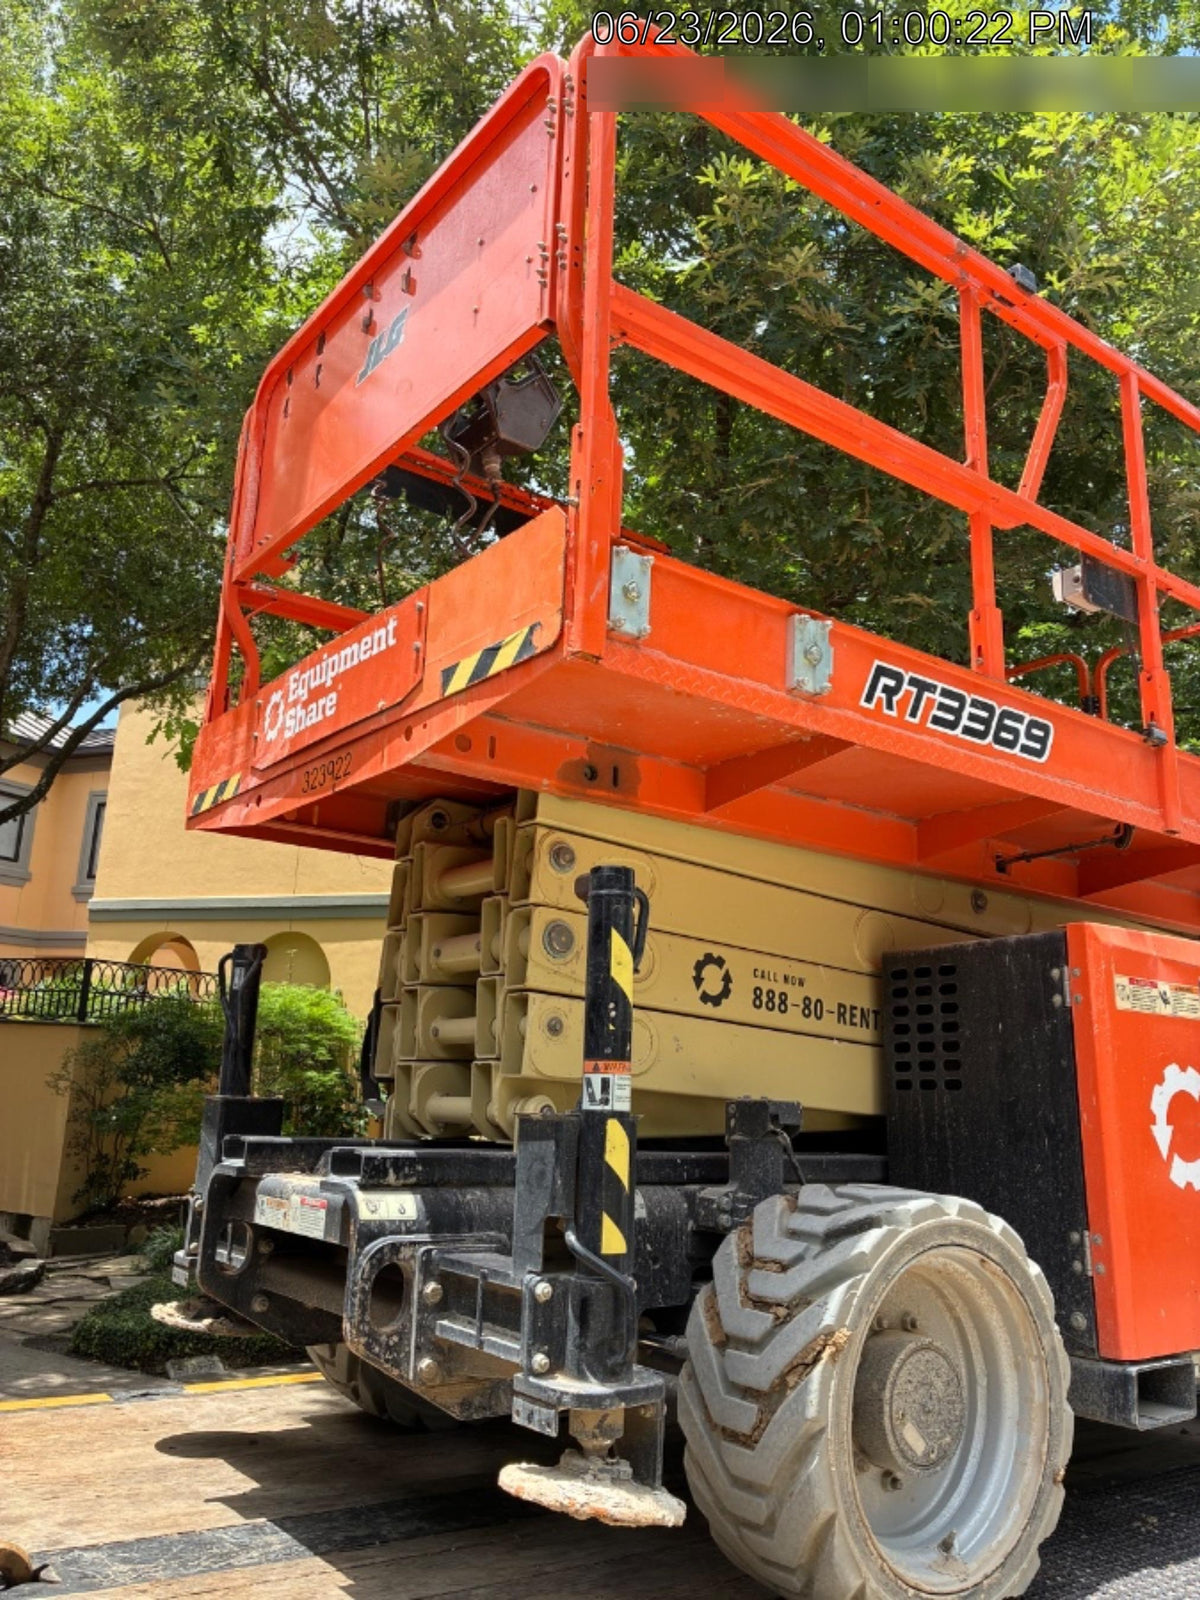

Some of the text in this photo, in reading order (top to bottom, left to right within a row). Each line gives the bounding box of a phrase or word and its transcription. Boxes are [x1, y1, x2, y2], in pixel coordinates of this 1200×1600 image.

[355, 303, 410, 388] JLG
[287, 615, 398, 703] Equipment
[283, 691, 338, 739] Share
[859, 659, 1054, 764] RT3369
[301, 751, 352, 793] 323922
[752, 967, 807, 988] CALL NOW
[751, 985, 882, 1031] 888-80-RENT
